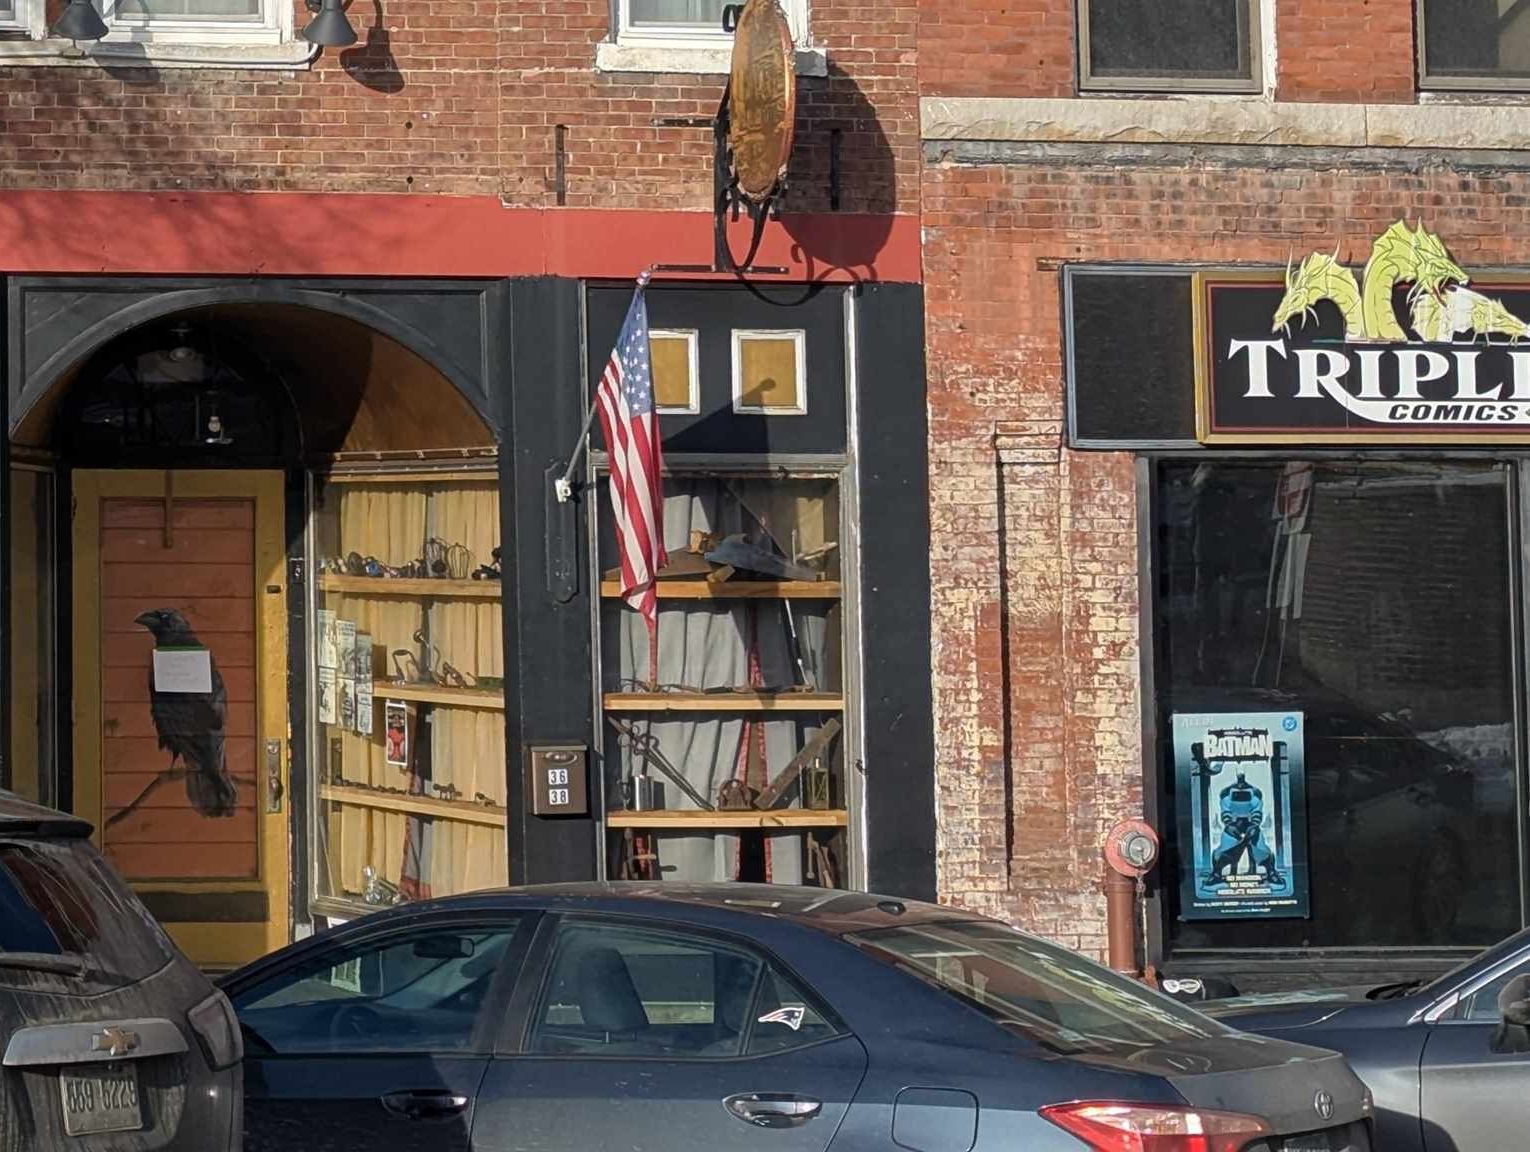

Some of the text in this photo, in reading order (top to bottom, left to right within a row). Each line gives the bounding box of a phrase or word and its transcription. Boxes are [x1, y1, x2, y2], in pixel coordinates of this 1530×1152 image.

[1388, 404, 1519, 421] COMICS
[1203, 734, 1273, 758] BATMAN
[550, 770, 566, 783] 36
[551, 790, 567, 803] 38
